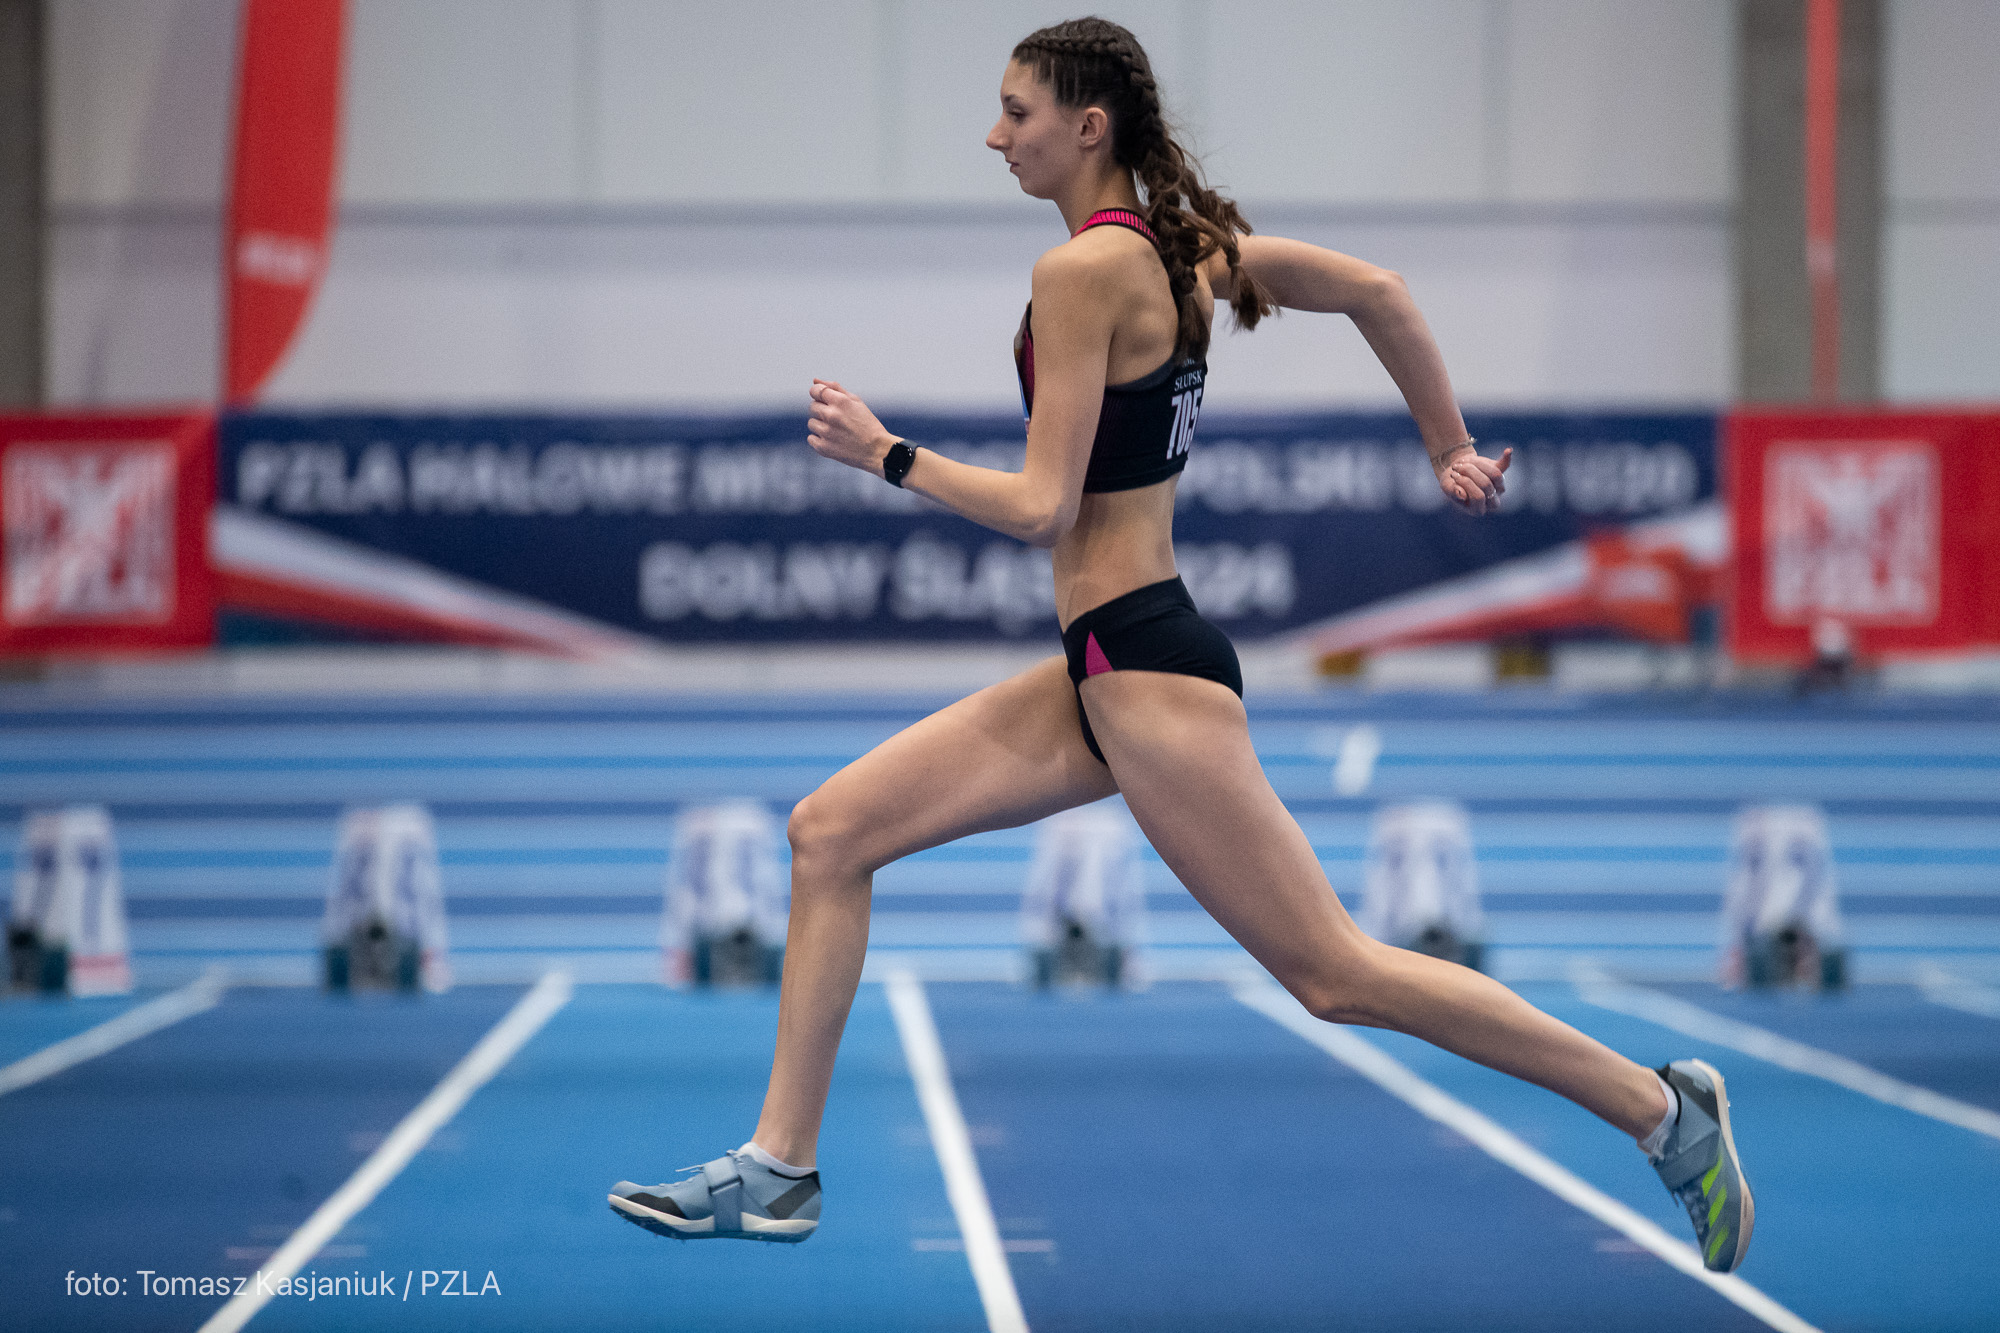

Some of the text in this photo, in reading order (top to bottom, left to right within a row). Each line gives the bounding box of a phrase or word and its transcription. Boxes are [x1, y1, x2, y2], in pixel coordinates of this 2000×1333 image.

[1174, 369, 1203, 392] SŁUPSK
[1166, 387, 1203, 460] 705
[237, 440, 403, 514] PZLA
